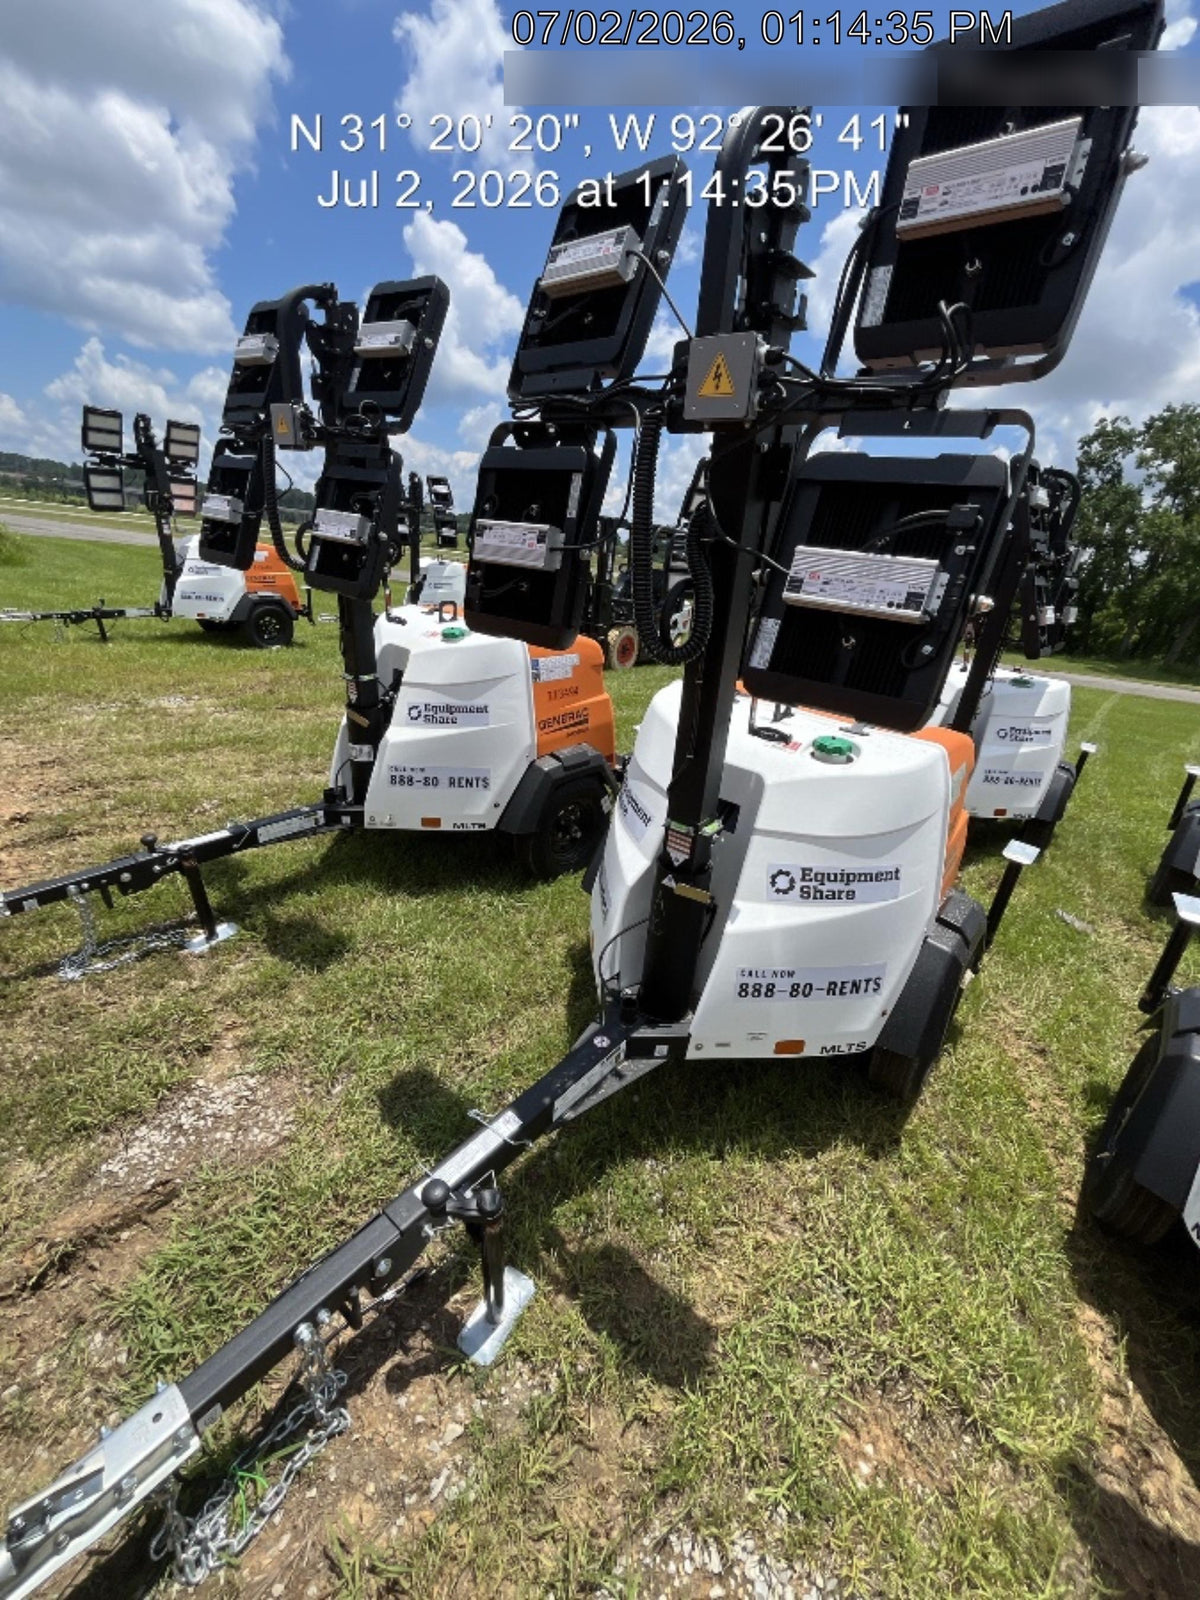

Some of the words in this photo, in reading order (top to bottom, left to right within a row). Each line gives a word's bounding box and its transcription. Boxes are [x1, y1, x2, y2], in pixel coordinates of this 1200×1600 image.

[424, 703, 489, 715] Equipment
[423, 714, 458, 724] Share
[800, 867, 901, 886] Equipment
[800, 885, 857, 901] Share
[740, 969, 767, 978] CALL
[771, 970, 796, 979] NOW
[738, 977, 882, 998] 888-80-RENTS
[820, 1041, 867, 1054] MLTS
